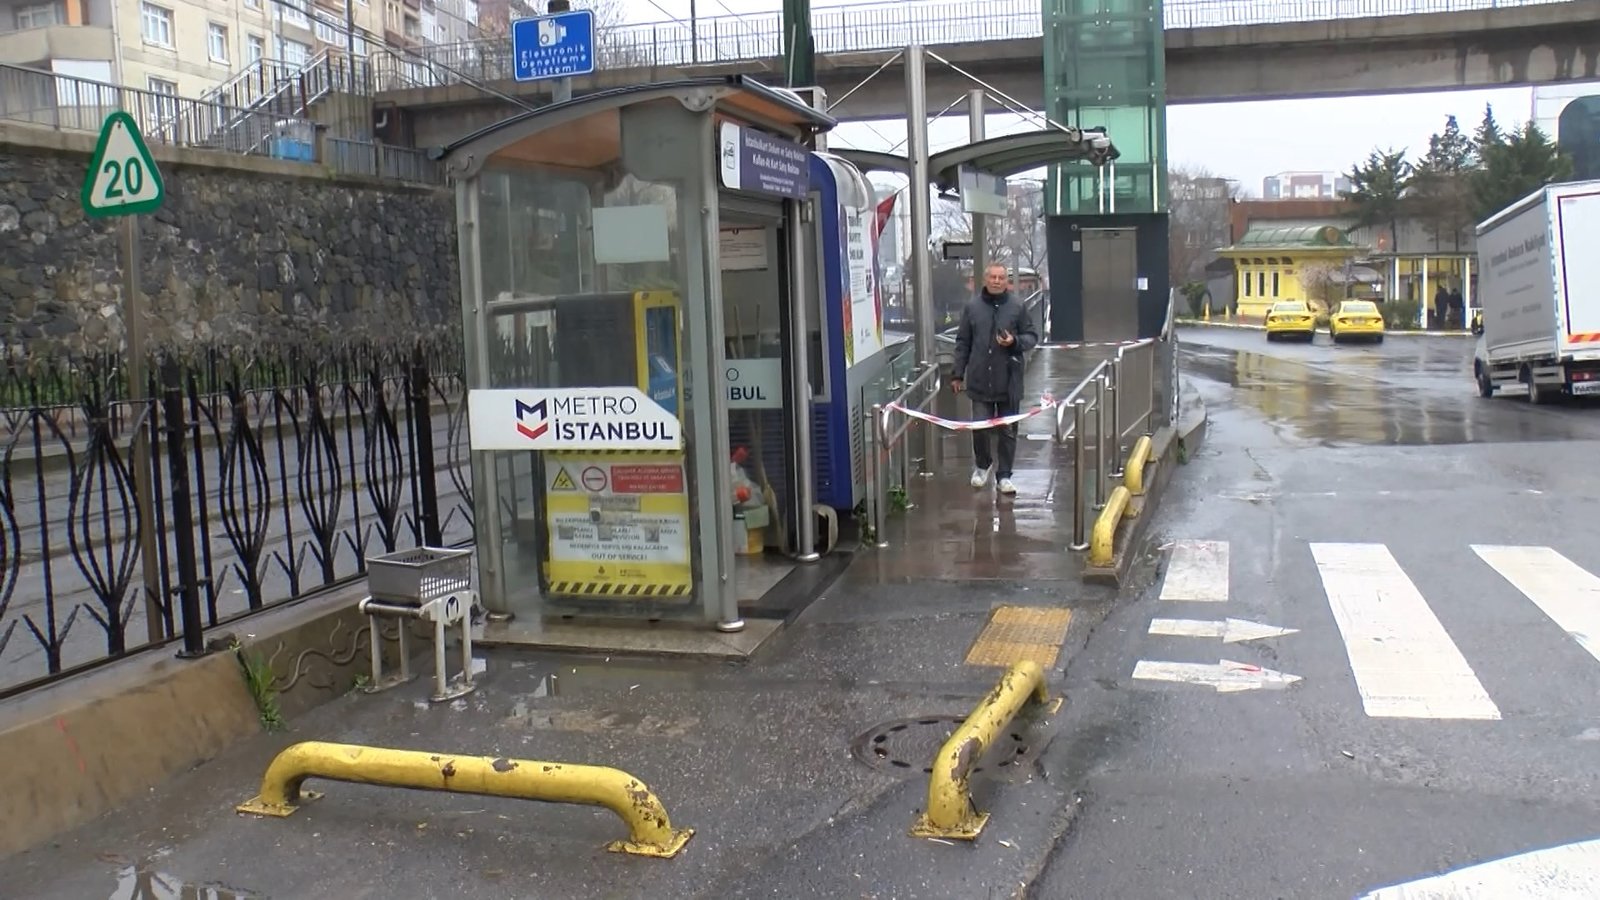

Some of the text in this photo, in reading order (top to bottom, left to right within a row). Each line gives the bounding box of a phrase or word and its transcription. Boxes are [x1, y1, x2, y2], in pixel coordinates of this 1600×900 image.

[521, 44, 586, 60] Elektronik
[521, 54, 587, 69] Denetleme
[530, 63, 577, 77] Sistemi
[103, 156, 143, 199] 20
[553, 396, 638, 415] METRO
[555, 418, 674, 441] İSTANBUL
[591, 553, 606, 561] OUT
